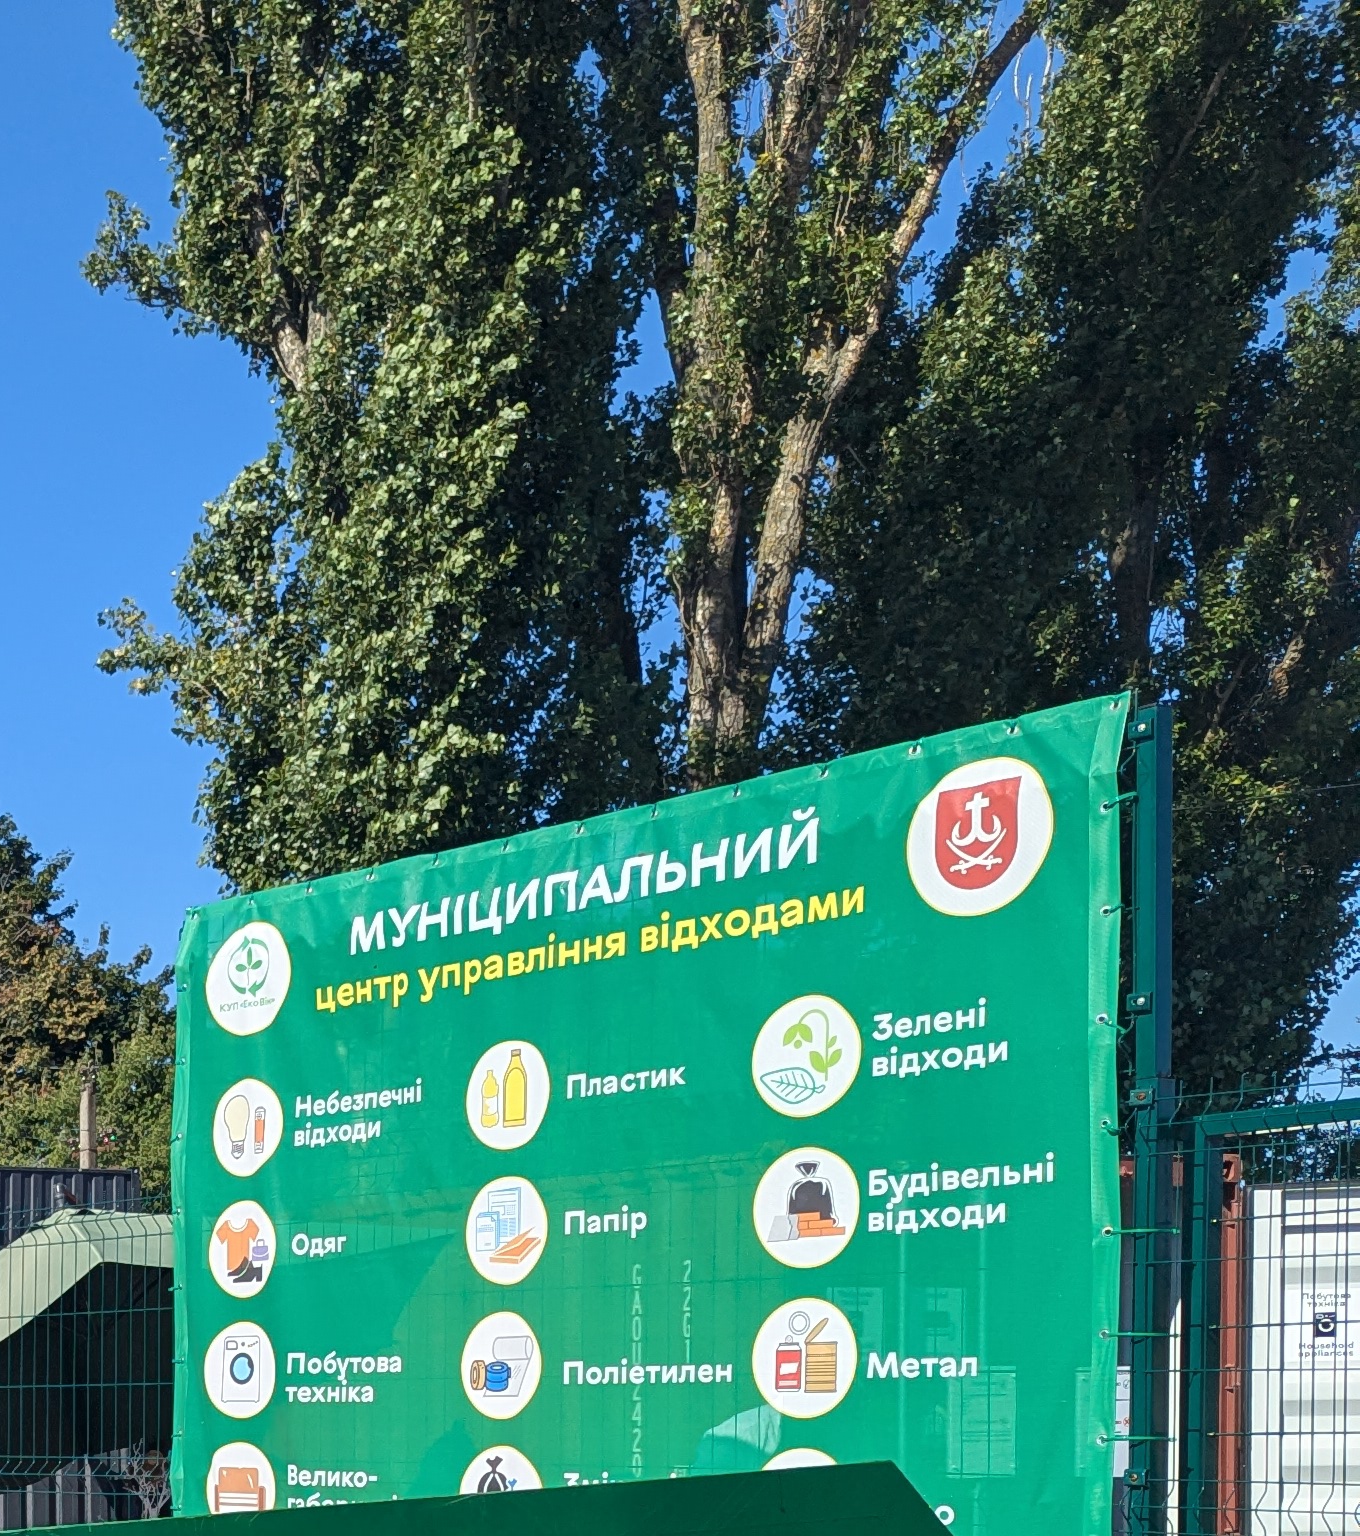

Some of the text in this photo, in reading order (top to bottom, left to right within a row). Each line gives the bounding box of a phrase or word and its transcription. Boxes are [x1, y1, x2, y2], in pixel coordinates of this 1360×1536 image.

[349, 806, 821, 957] МУНІЦИПАЛЬНИЙ
[315, 886, 866, 1012] центр управління відходами
[872, 998, 987, 1041] Зелені
[871, 1041, 1009, 1079] відходи
[295, 1077, 423, 1118] Небезпечні
[566, 1066, 686, 1099] Пластик
[293, 1119, 382, 1148] відходи
[868, 1151, 1055, 1200] Будівельні
[564, 1204, 648, 1239] Папір
[868, 1202, 1007, 1235] відходи
[291, 1233, 348, 1258] Одяг
[1298, 1341, 1354, 1350] Househod
[286, 1350, 402, 1378] Побутова
[563, 1357, 733, 1386] Поліетилен
[866, 1351, 979, 1379] Метал
[285, 1381, 374, 1404] техніка
[287, 1463, 378, 1489] Велико-
